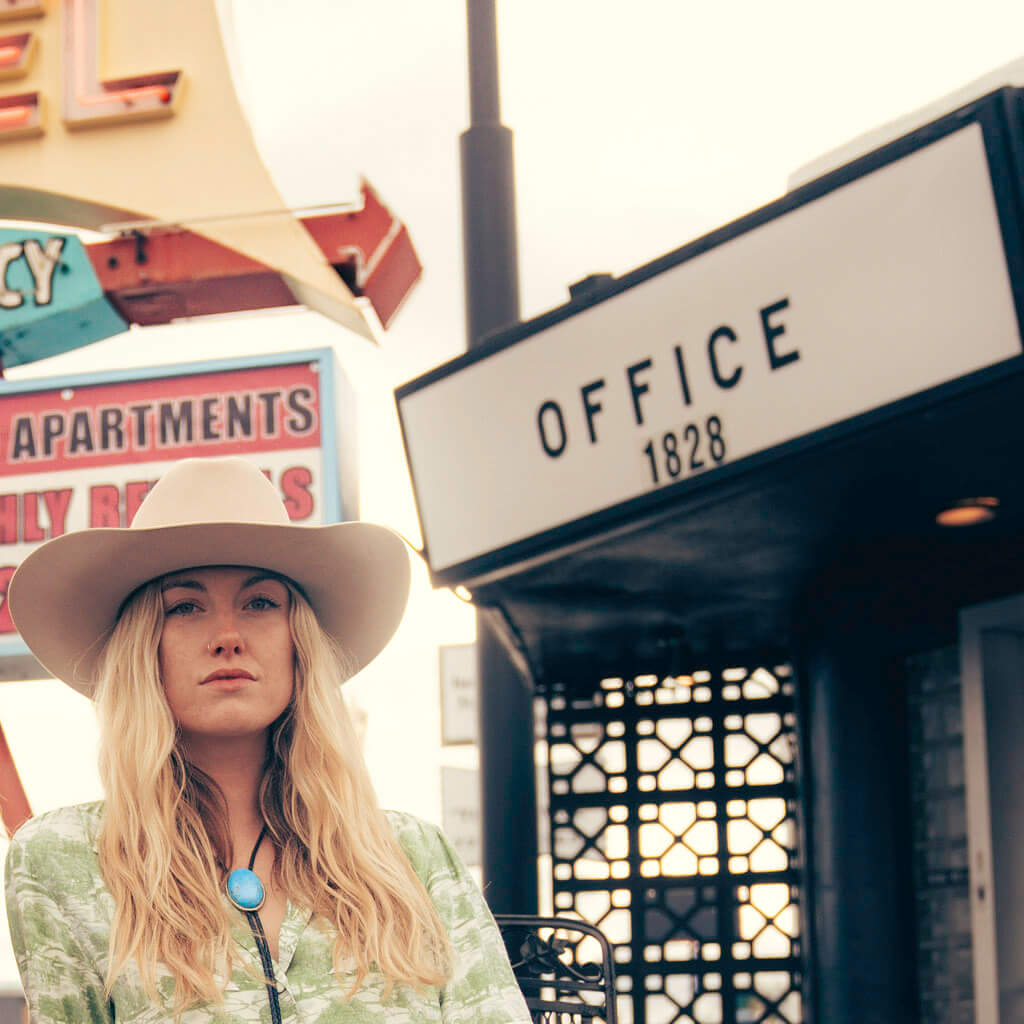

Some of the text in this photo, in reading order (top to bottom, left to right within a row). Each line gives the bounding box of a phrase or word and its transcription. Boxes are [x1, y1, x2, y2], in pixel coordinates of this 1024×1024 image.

[536, 298, 801, 460] OFFICE
[11, 387, 316, 460] APARTMENTS
[643, 415, 727, 485] 1828
